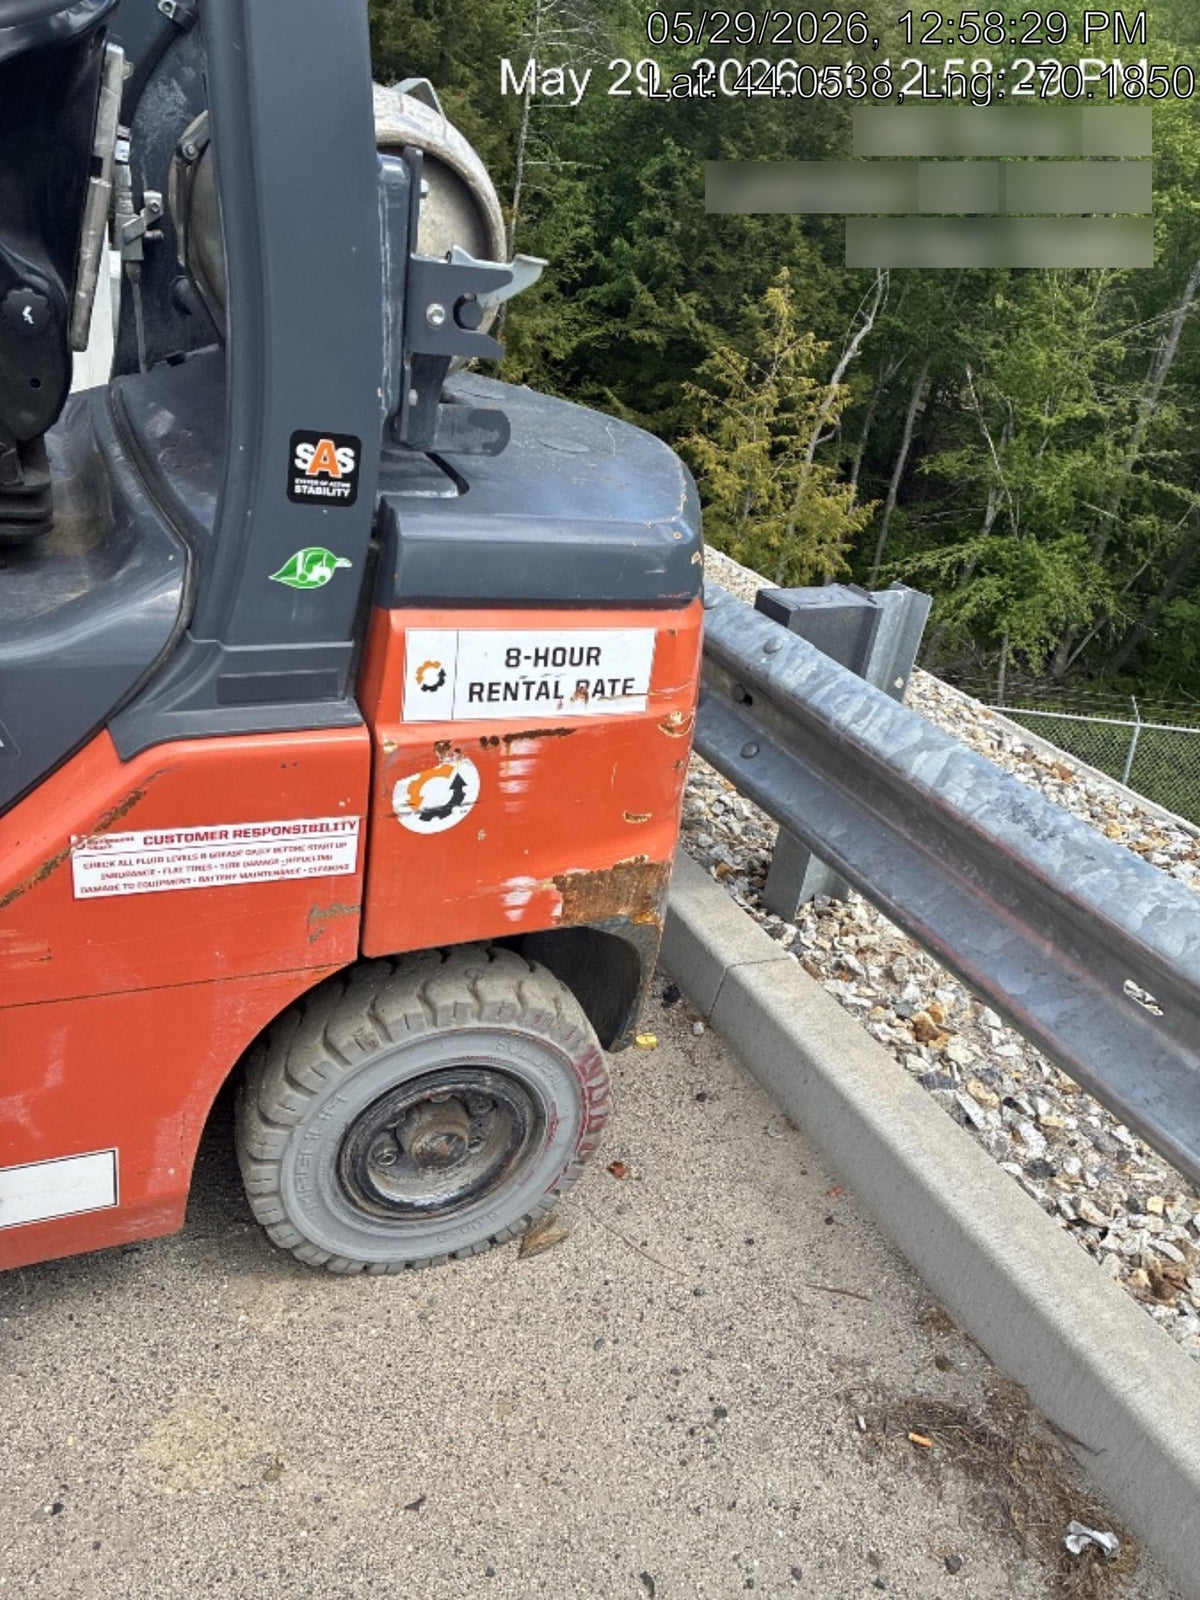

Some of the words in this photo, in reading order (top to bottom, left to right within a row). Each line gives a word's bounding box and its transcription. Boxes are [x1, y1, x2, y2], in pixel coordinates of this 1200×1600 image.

[294, 438, 355, 478] SAS
[294, 484, 351, 498] STABILITY
[504, 646, 602, 668] 8-HOUR
[467, 678, 565, 704] RENTAL
[143, 830, 229, 846] CUSTOMER
[232, 821, 357, 839] RESPONSIBILITY
